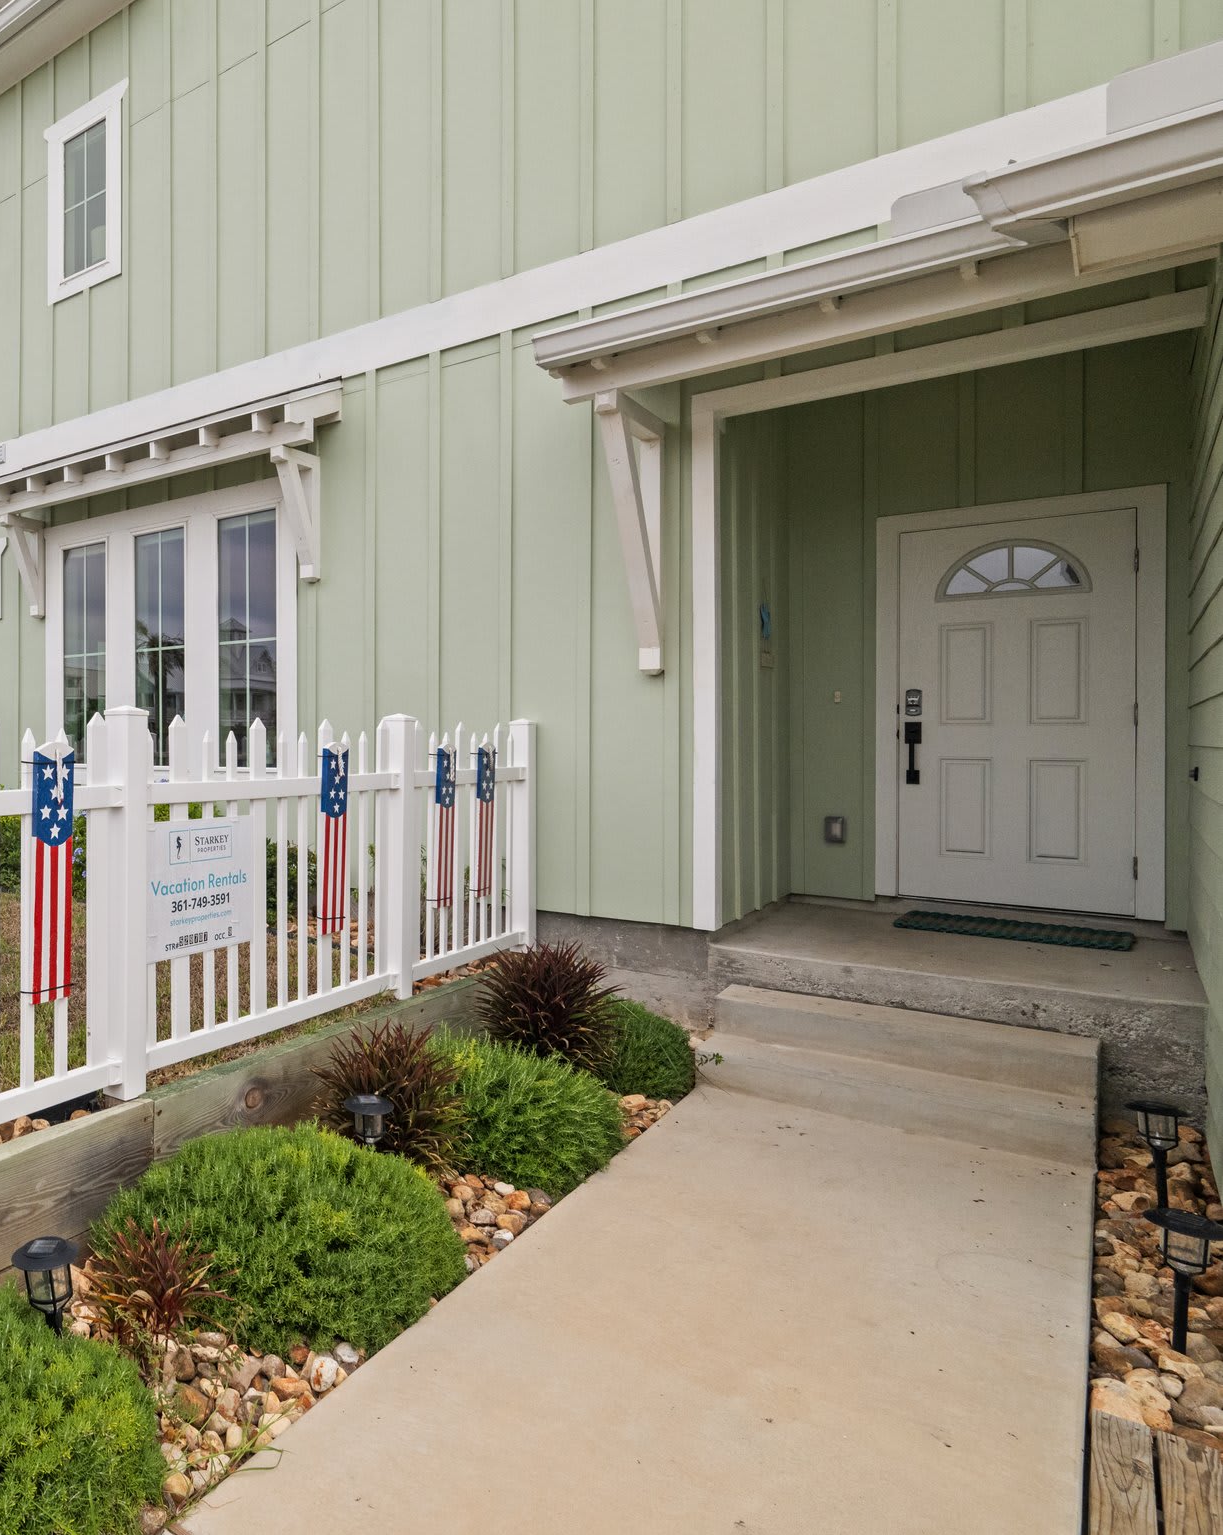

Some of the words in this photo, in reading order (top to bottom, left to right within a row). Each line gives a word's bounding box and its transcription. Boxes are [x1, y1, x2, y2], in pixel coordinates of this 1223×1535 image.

[194, 834, 229, 847] STARKEY
[197, 844, 226, 853] PROPERTIES
[151, 877, 205, 896] Vacation
[208, 869, 247, 888] Rentals
[171, 892, 230, 913] 361-749-3591
[170, 909, 232, 927] starkeyproperties.com
[214, 932, 225, 941] OCC
